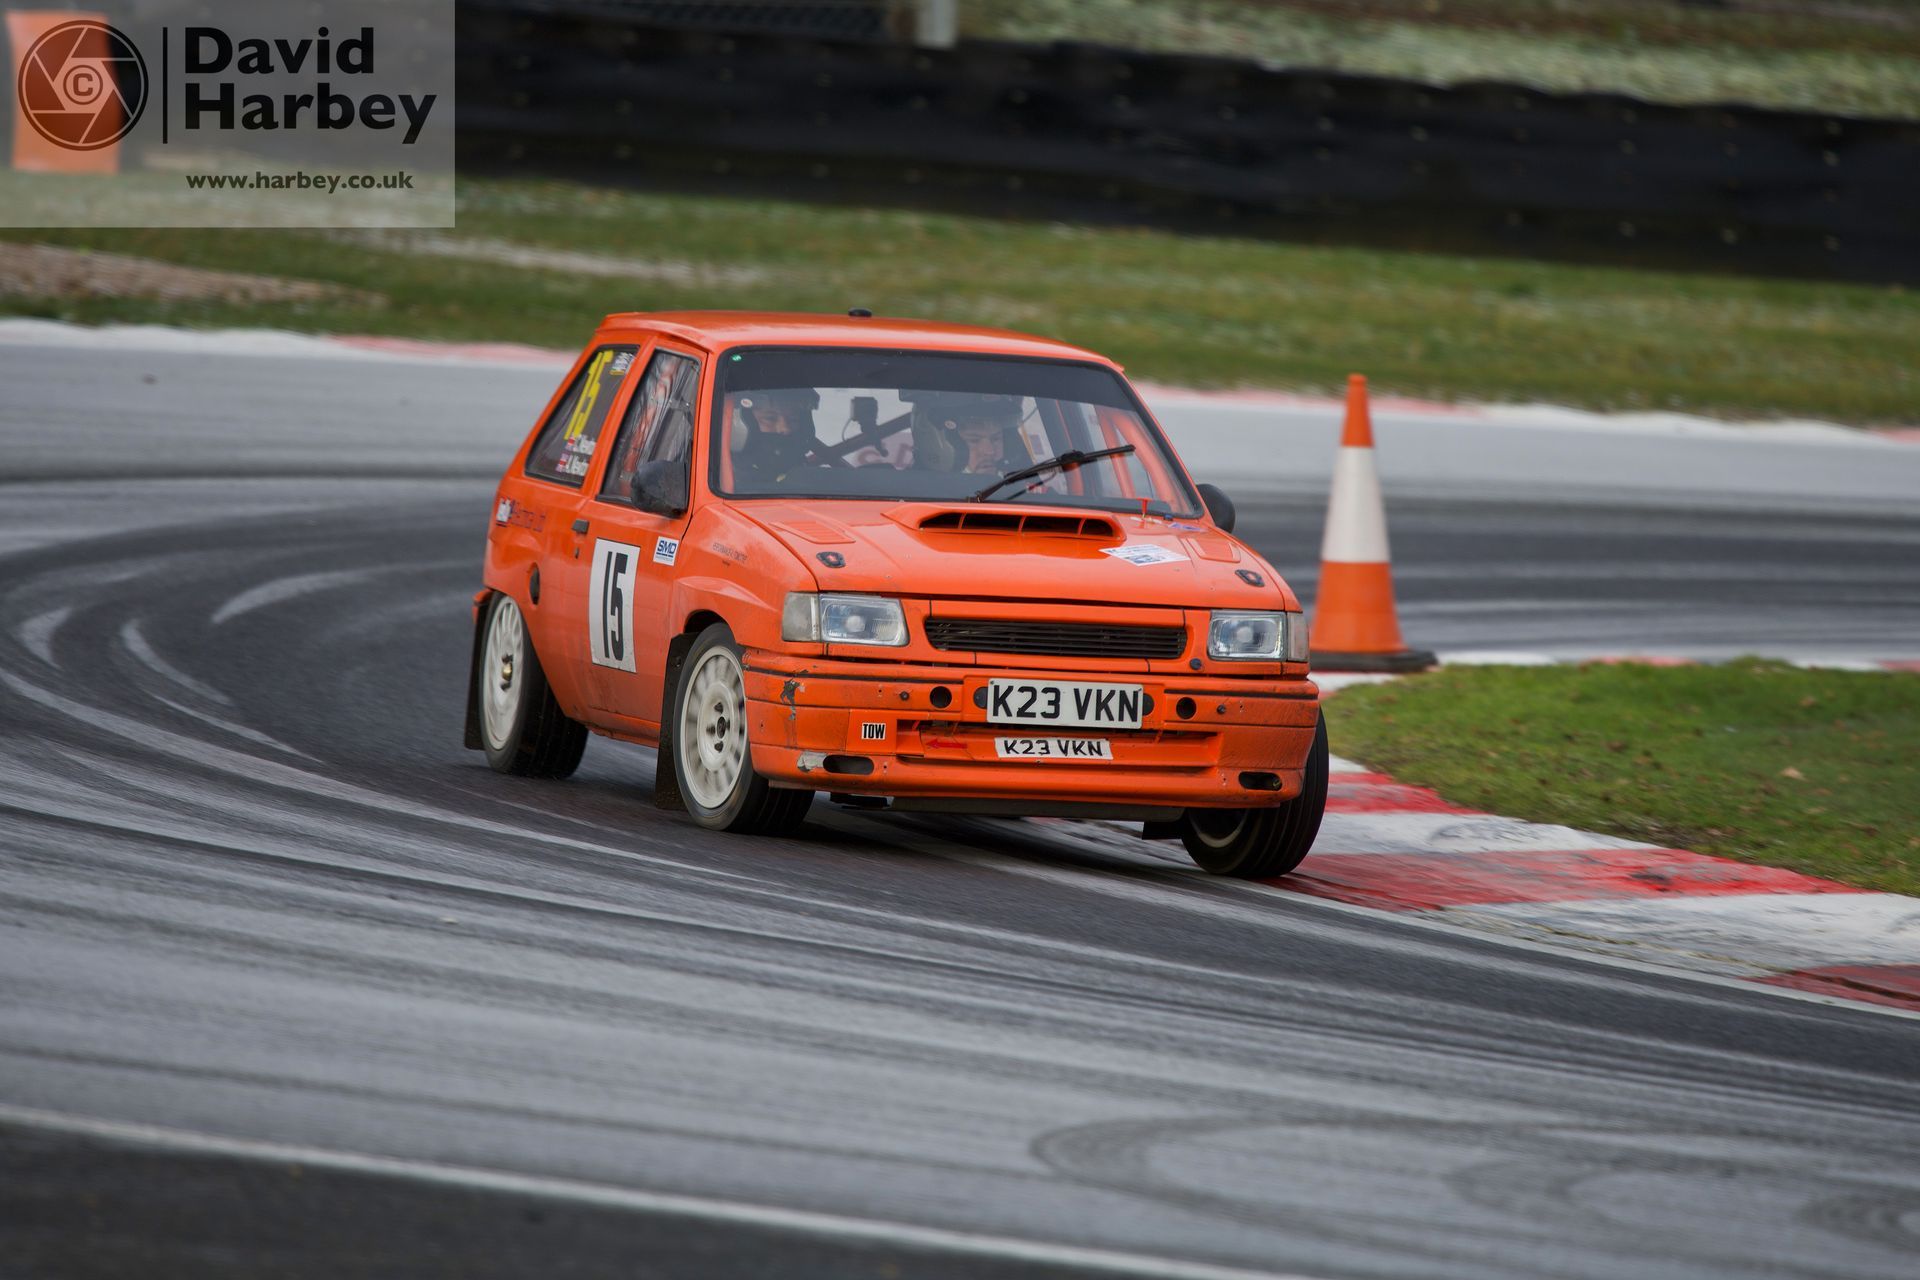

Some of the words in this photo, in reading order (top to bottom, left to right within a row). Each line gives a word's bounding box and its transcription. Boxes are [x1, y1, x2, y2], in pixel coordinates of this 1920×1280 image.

[563, 350, 614, 440] 15
[657, 540, 677, 554] SMD
[603, 551, 628, 661] 15
[992, 684, 1061, 719] K23
[1073, 688, 1139, 722] VKN
[862, 723, 886, 739] TOW
[1003, 738, 1051, 756] K23
[1056, 739, 1104, 757] VKN
